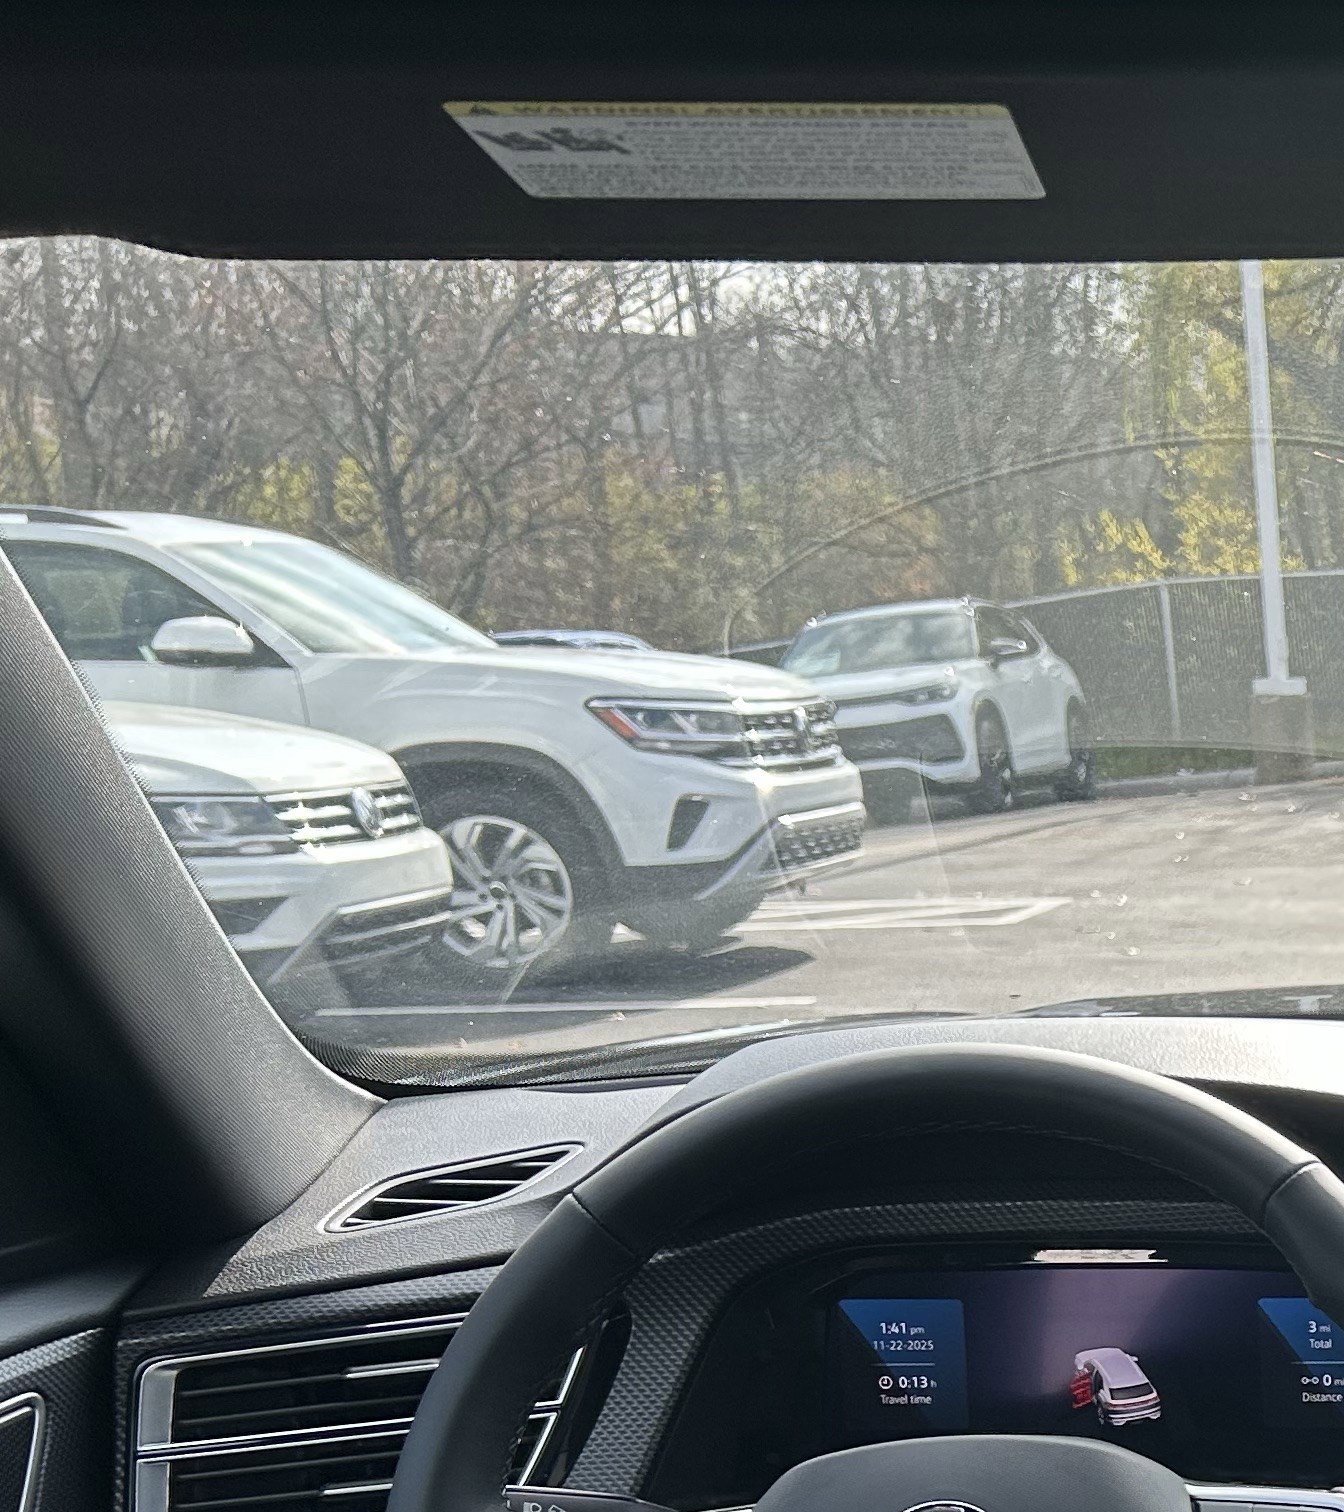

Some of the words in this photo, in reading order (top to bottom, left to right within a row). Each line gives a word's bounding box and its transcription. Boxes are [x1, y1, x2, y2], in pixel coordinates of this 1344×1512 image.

[880, 1322, 906, 1335] 1:41
[910, 1327, 925, 1335] pm
[1308, 1321, 1317, 1333] 3
[1319, 1325, 1331, 1333] mi
[873, 1340, 934, 1351] 11-22-2025
[1308, 1338, 1333, 1349] Total
[898, 1376, 928, 1389] 0:13
[1322, 1374, 1332, 1387] 0
[880, 1394, 909, 1405] Travel
[910, 1394, 932, 1405] time
[1301, 1391, 1344, 1402] Distance
